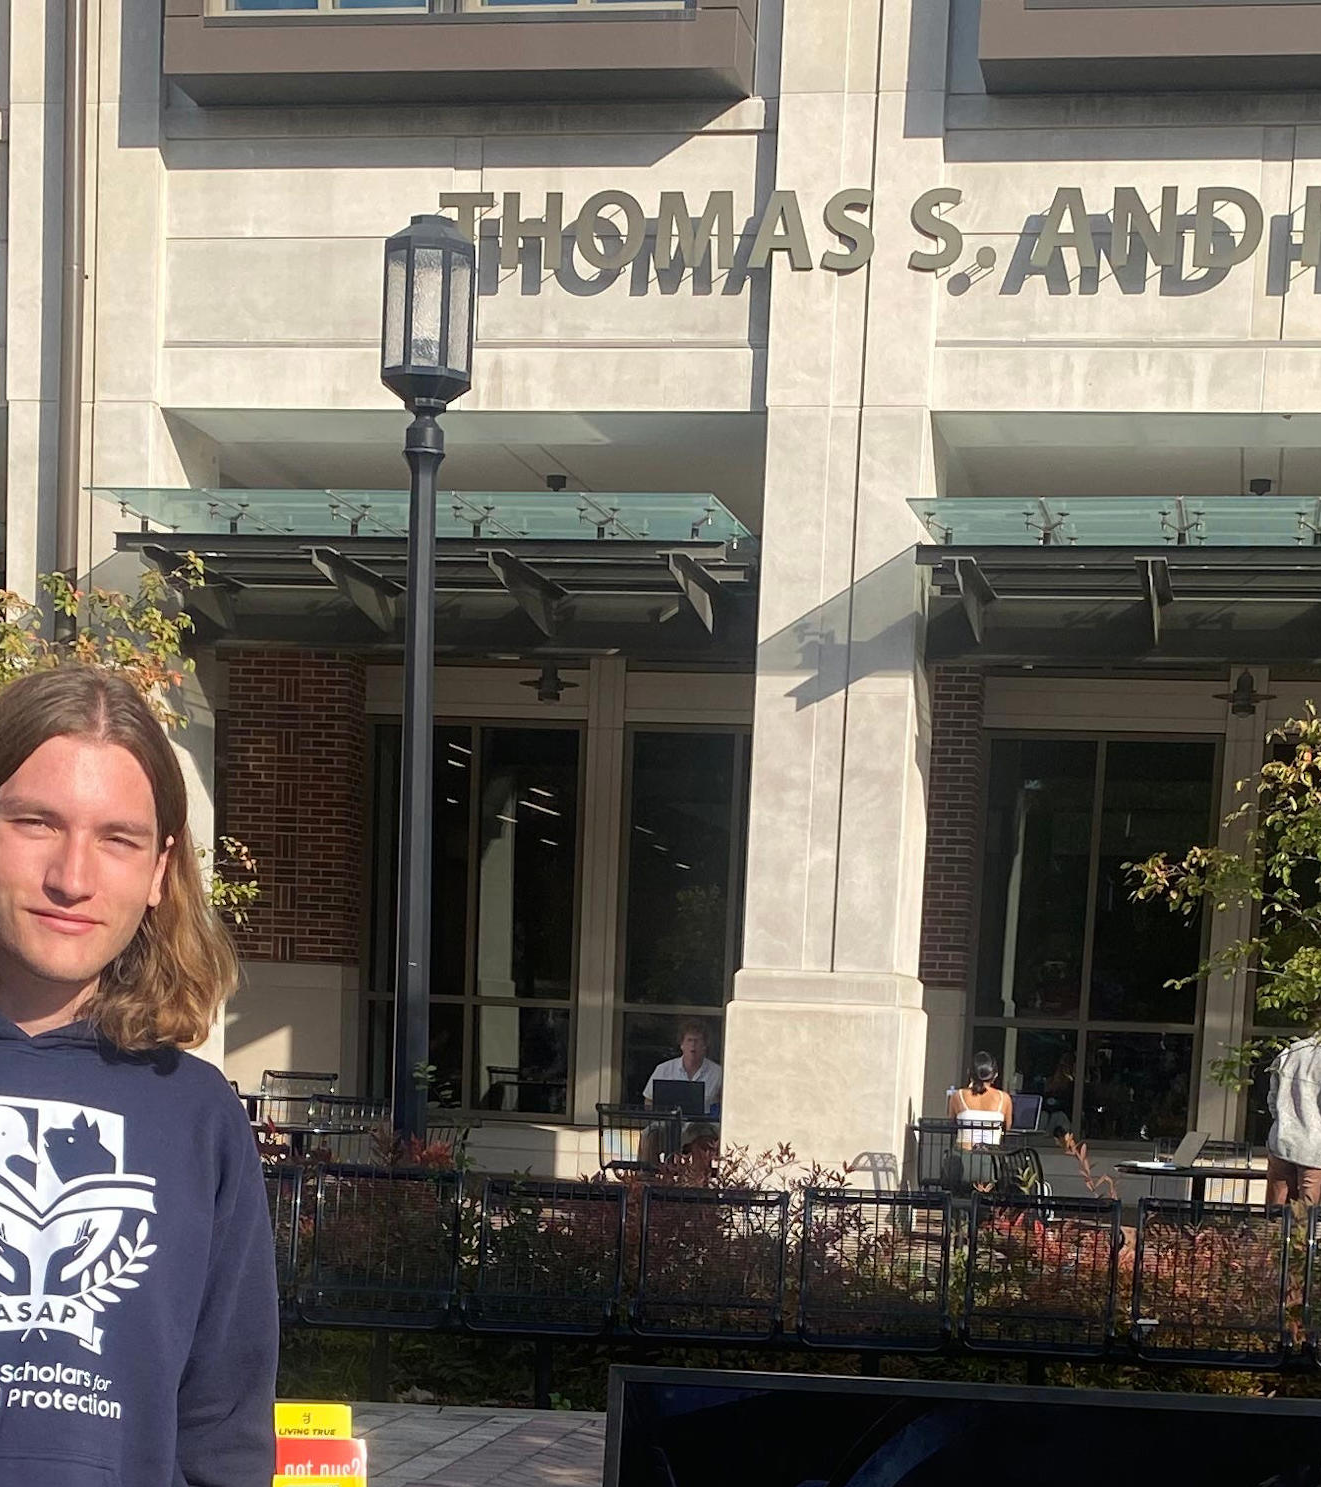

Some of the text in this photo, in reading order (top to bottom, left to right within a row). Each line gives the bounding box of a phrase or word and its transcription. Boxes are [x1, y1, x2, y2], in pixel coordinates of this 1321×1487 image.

[439, 187, 874, 273] THOMAS
[907, 186, 996, 274] S.
[1034, 184, 1265, 270] AND
[0, 1360, 91, 1390] Scholars
[91, 1373, 112, 1393] for
[6, 1387, 122, 1421] Protection
[278, 1427, 337, 1437] LIVING TRUE
